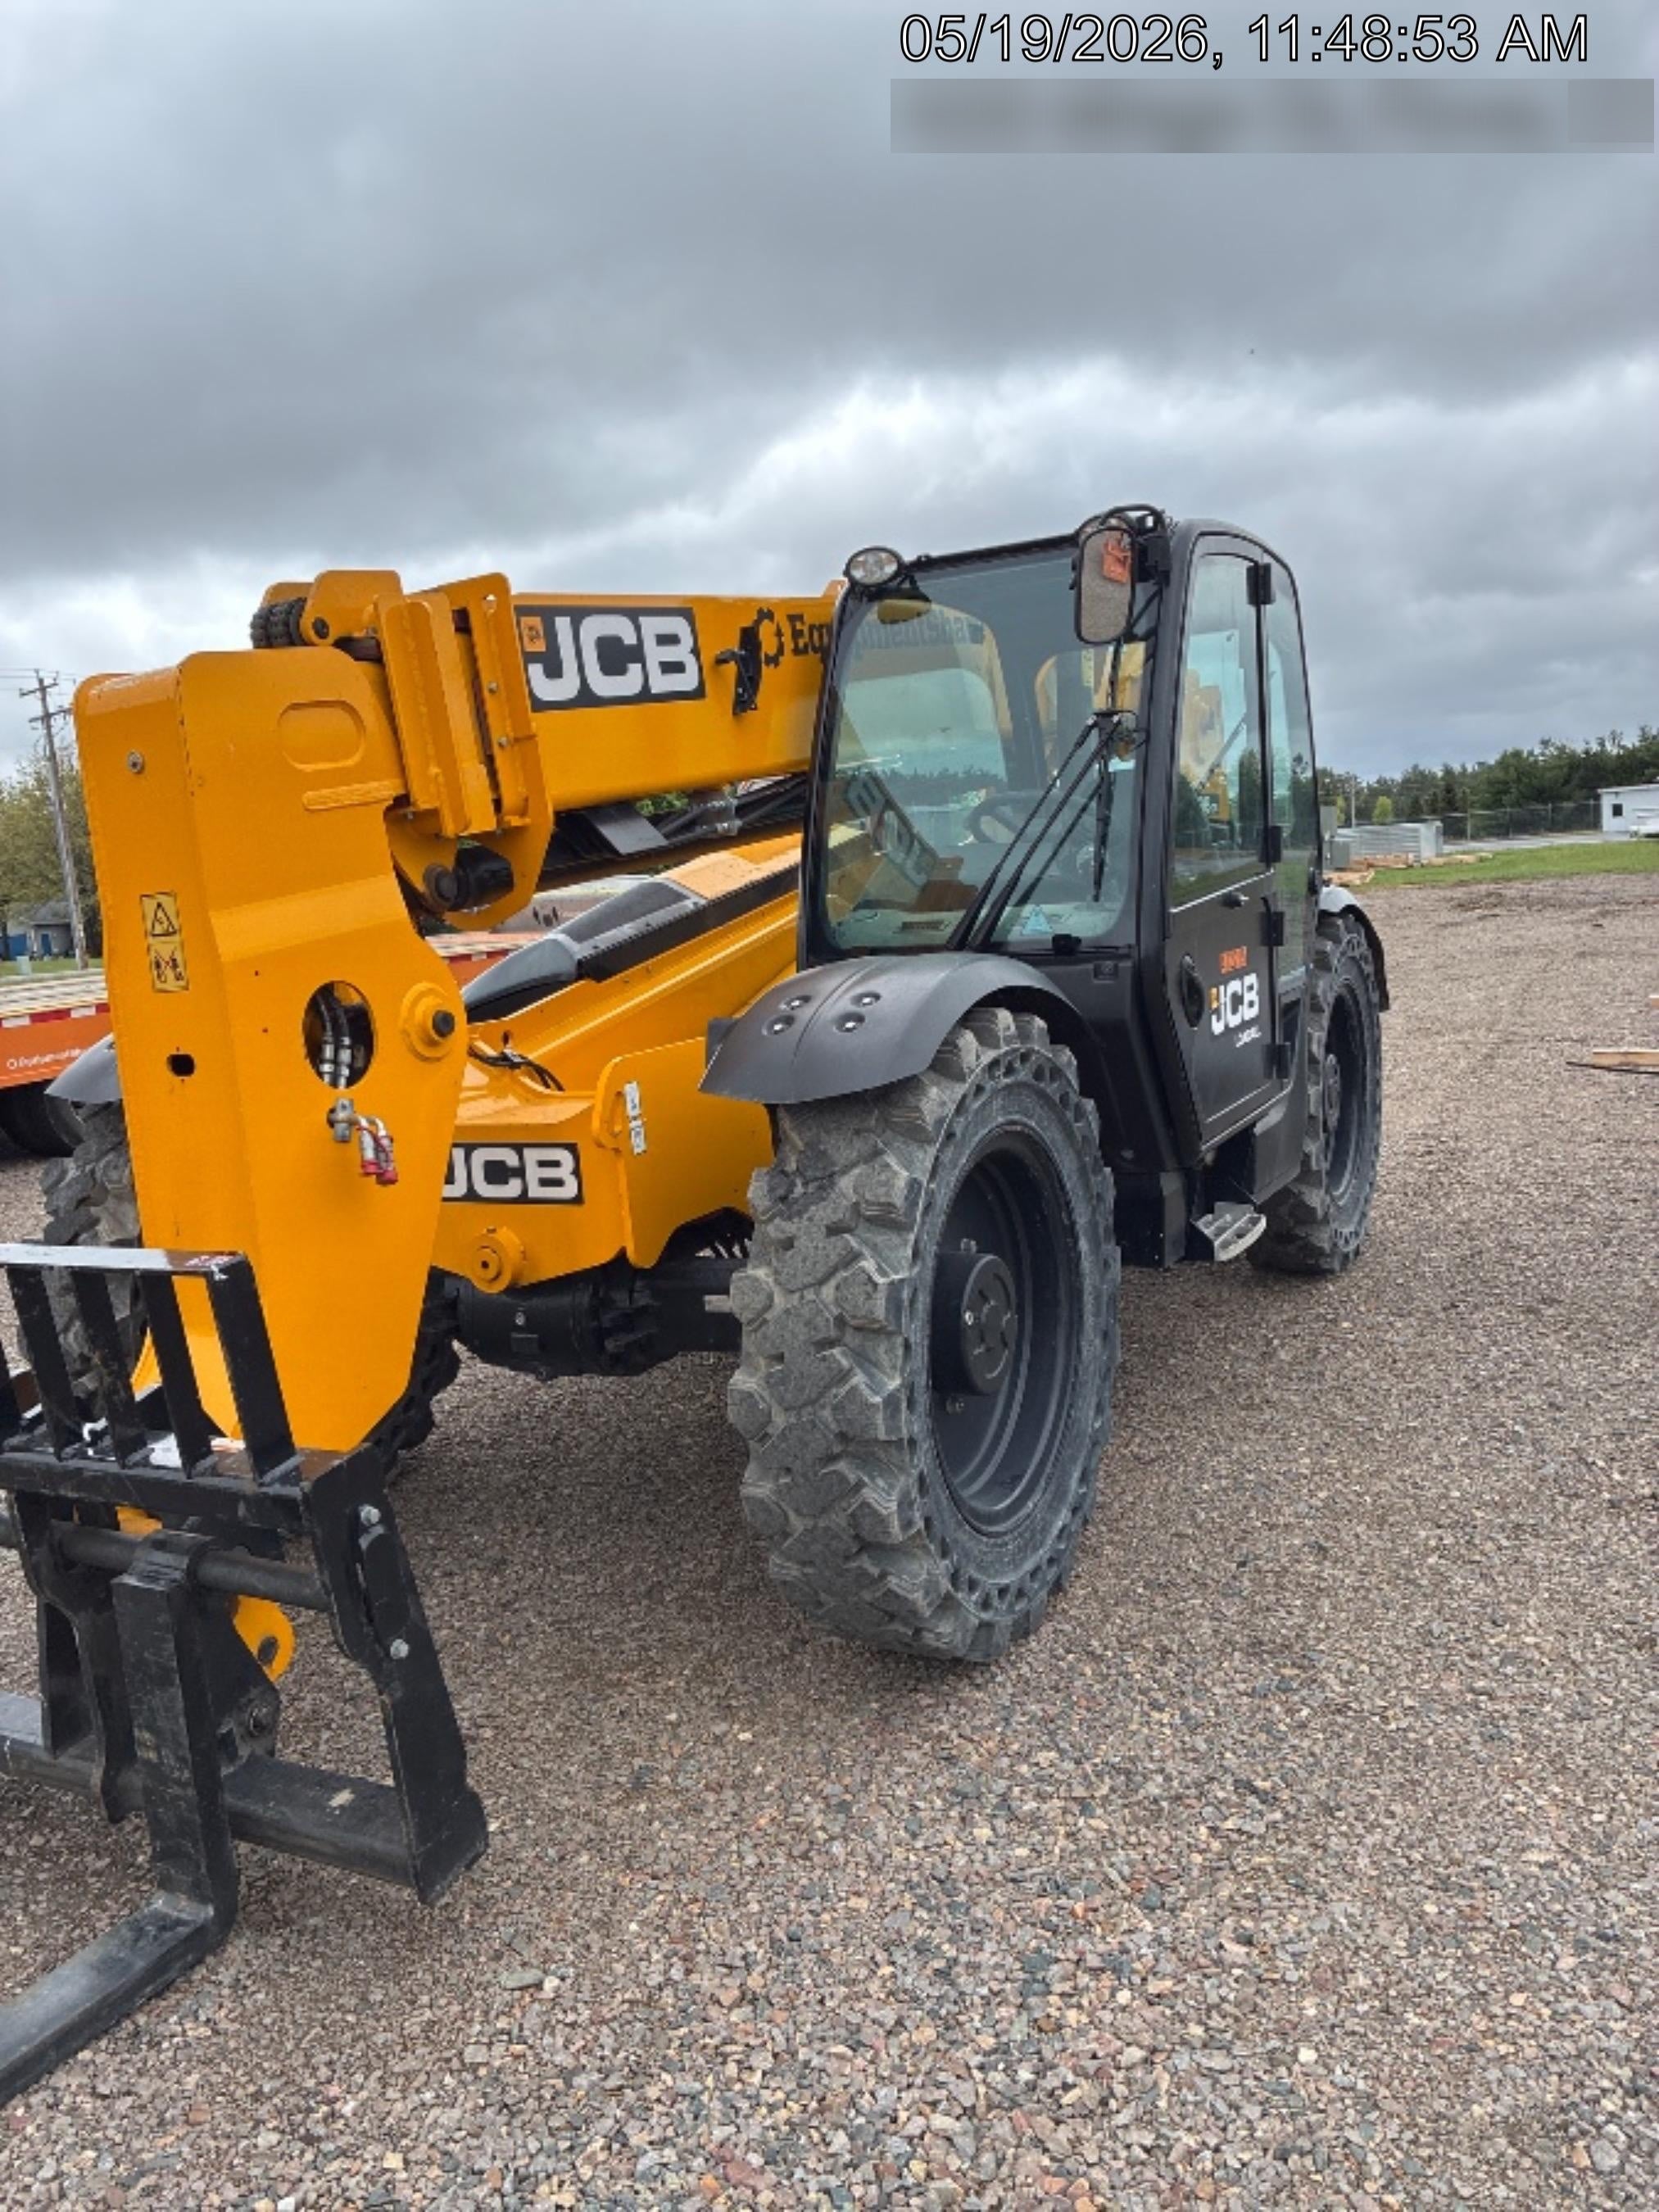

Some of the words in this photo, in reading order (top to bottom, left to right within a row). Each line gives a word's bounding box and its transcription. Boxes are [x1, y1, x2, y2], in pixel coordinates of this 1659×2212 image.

[528, 614, 700, 701] JCB
[1211, 972, 1260, 1036] JCB
[442, 1147, 579, 1199] JCB
